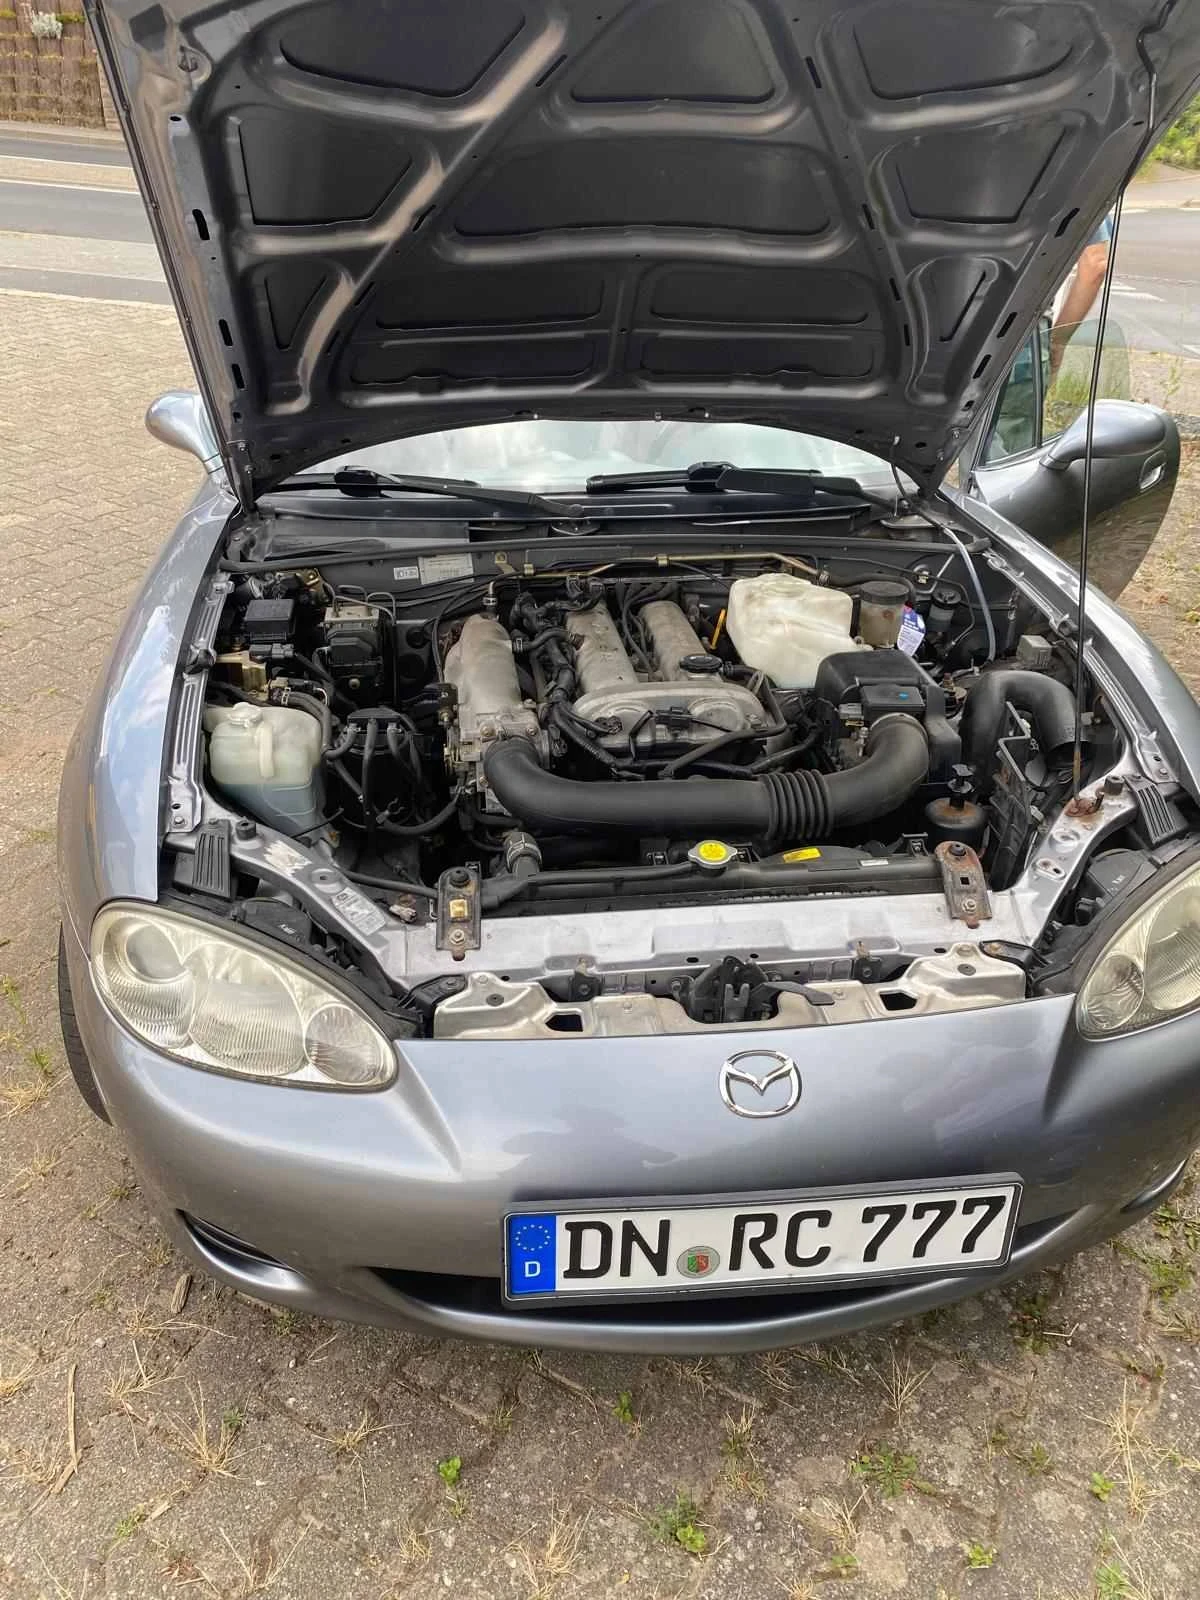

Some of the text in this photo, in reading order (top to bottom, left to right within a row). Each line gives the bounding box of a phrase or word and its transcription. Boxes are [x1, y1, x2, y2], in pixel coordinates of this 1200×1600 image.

[563, 1195, 1007, 1279] DN RC 777
[525, 1261, 541, 1278] D
